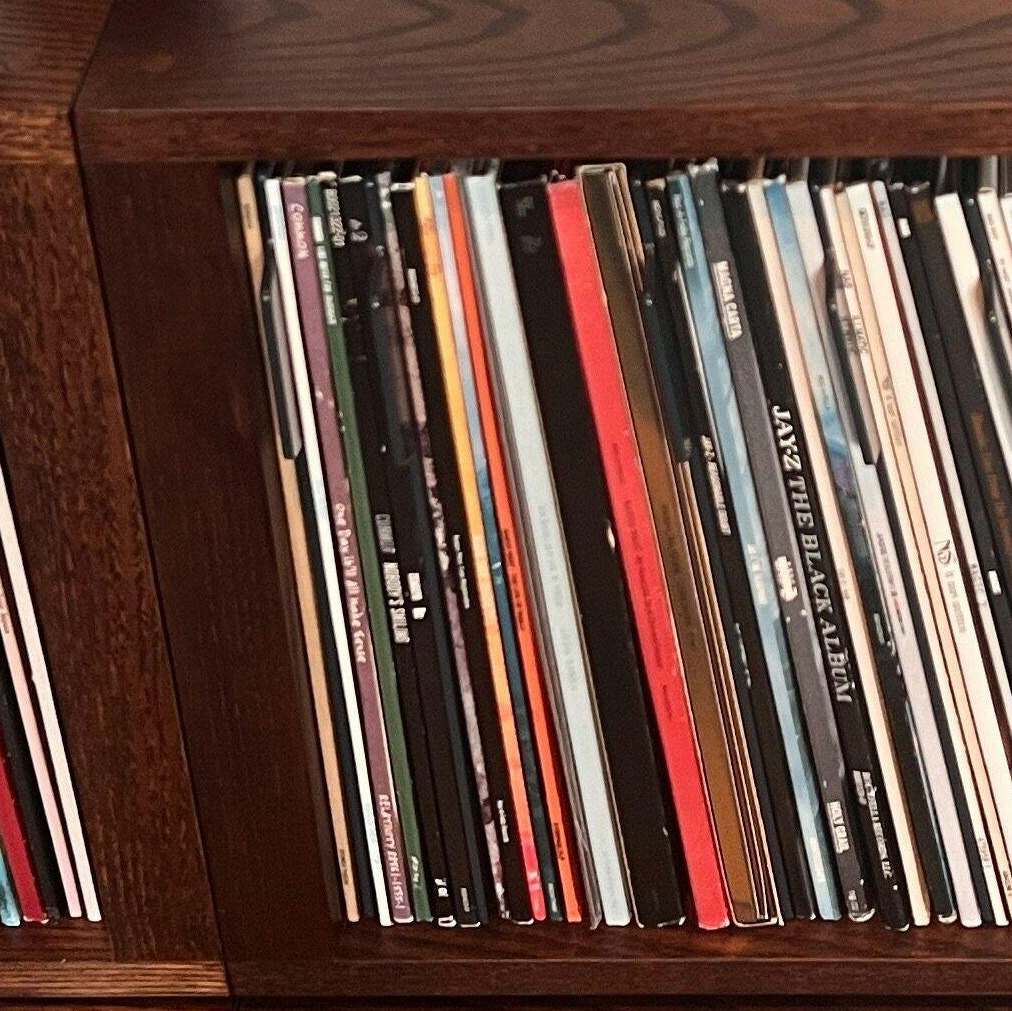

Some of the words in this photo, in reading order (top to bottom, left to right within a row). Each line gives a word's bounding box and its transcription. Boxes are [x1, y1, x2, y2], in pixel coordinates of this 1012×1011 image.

[786, 473, 815, 531] THE
[798, 530, 834, 616] BLACK
[817, 614, 854, 705] ALBUM
